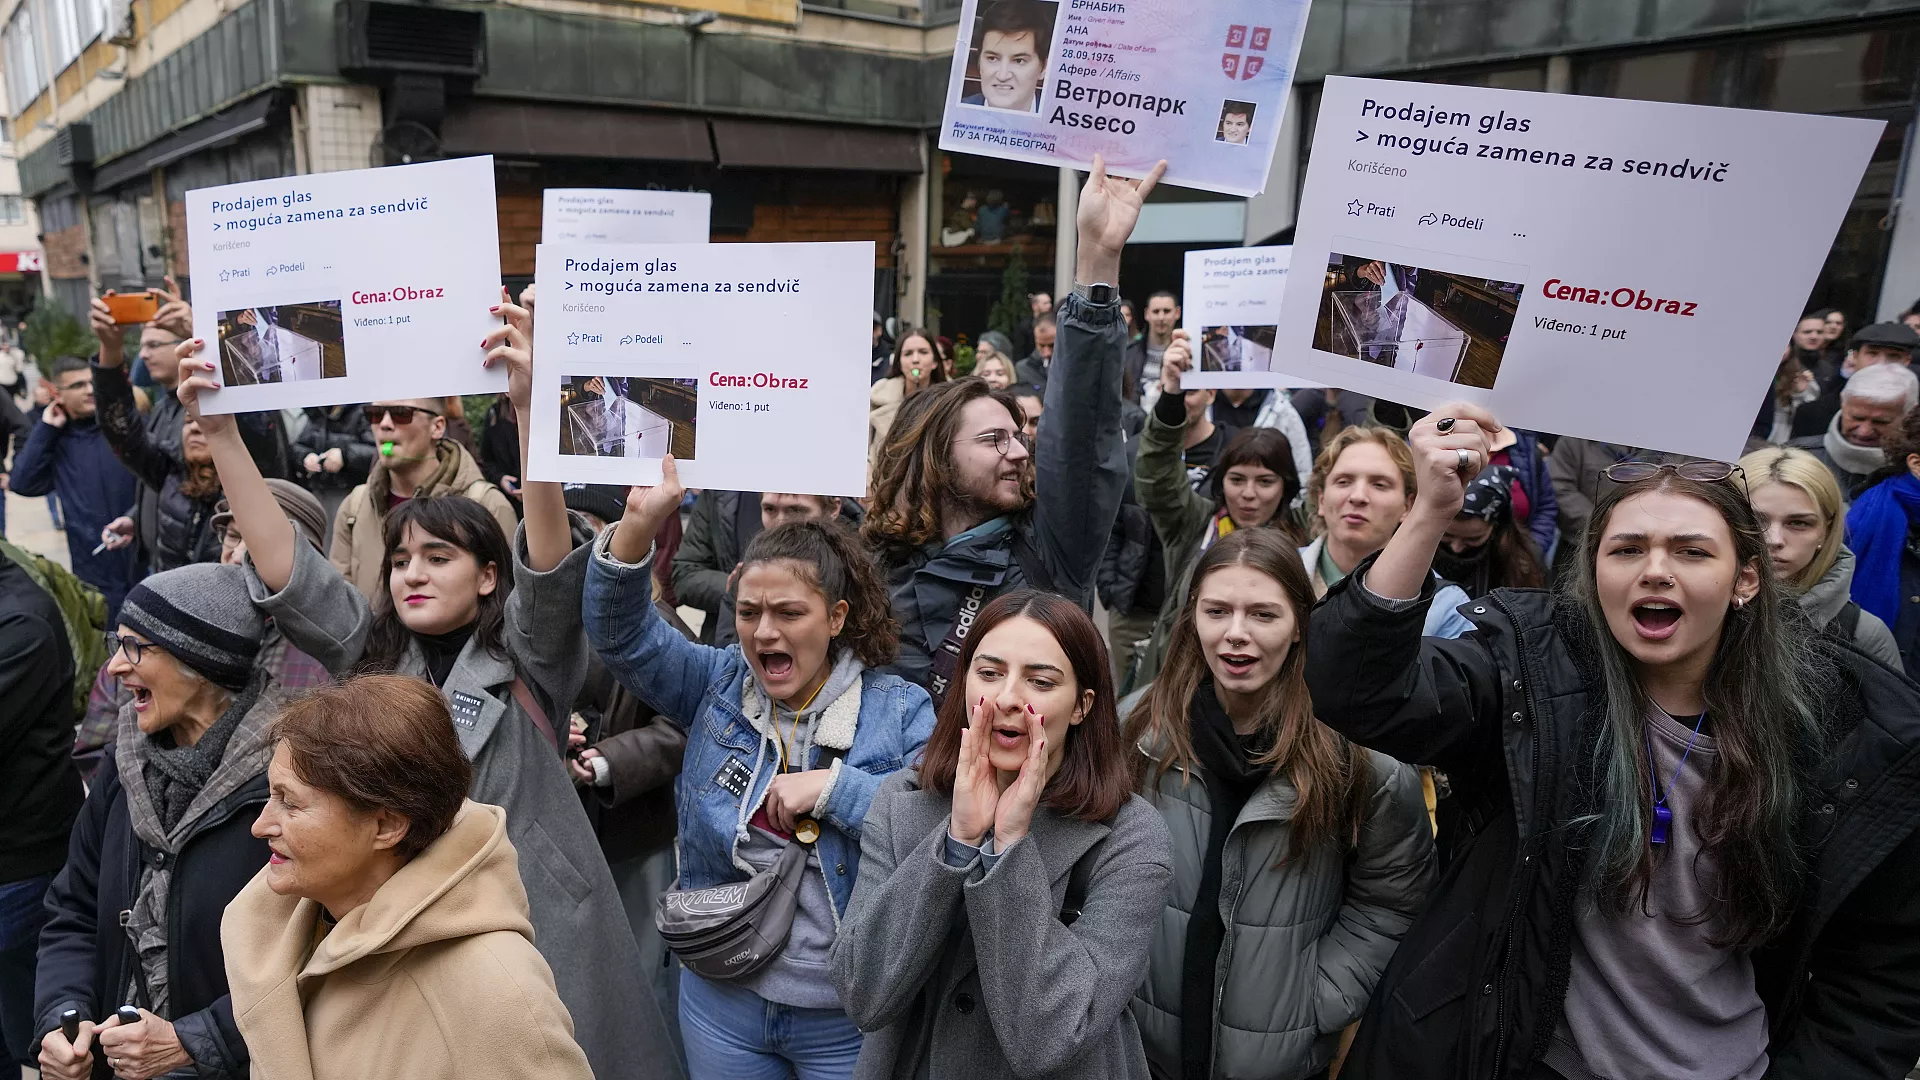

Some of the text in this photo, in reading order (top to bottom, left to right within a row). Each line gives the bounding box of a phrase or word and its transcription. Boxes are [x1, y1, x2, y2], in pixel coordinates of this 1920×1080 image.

[1066, 25, 1088, 35] АНА
[1062, 49, 1116, 63] 28.09.1975.
[1059, 63, 1097, 77] Афере
[1106, 68, 1141, 82] Affairs
[1055, 79, 1187, 117] Ветропарк
[1049, 105, 1136, 134] Asseco
[1362, 99, 1531, 134] Prodajem glas
[953, 129, 1055, 152] ПУ ЗА ГРАД БЕОГРАД
[1377, 133, 1469, 155] moguća
[1477, 144, 1576, 167] zamena
[1584, 155, 1613, 171] za
[1622, 158, 1730, 182] sendvič
[1348, 159, 1407, 177] Korišćeno
[212, 190, 312, 213] Prodajem glas
[1367, 203, 1396, 217] Prati
[227, 213, 281, 231] moguća
[287, 208, 343, 223] zamena
[349, 206, 365, 217] za
[370, 197, 428, 215] sendvič
[1441, 214, 1484, 230] Podeli
[213, 240, 250, 252] Korišćeno
[279, 262, 305, 273] Podeli
[566, 258, 677, 275] Prodajem glas
[1204, 255, 1276, 266] Prodajem glas
[232, 268, 250, 278] Prati
[352, 286, 444, 305] Cena:Obraz
[580, 279, 642, 295] moguća
[648, 282, 709, 292] zamena
[714, 282, 732, 292] za
[738, 279, 800, 293] sendvič
[1542, 279, 1698, 316] Cena:Obraz
[562, 303, 605, 312] Korišćeno
[354, 315, 410, 327] Viđeno: 1 put
[1534, 316, 1627, 340] Viđeno: 1 put
[582, 333, 602, 342] Prati
[635, 335, 663, 343] Podeli
[709, 372, 808, 389] Cena:Obraz
[709, 401, 770, 413] Viđeno: 1 put
[956, 584, 986, 638] adida
[456, 694, 481, 706] SKINITE
[456, 718, 473, 727] ASTI
[719, 776, 740, 795] VLASTI
[734, 774, 742, 782] SE
[666, 884, 749, 915] EXTREM
[724, 948, 752, 966] EXTREM
